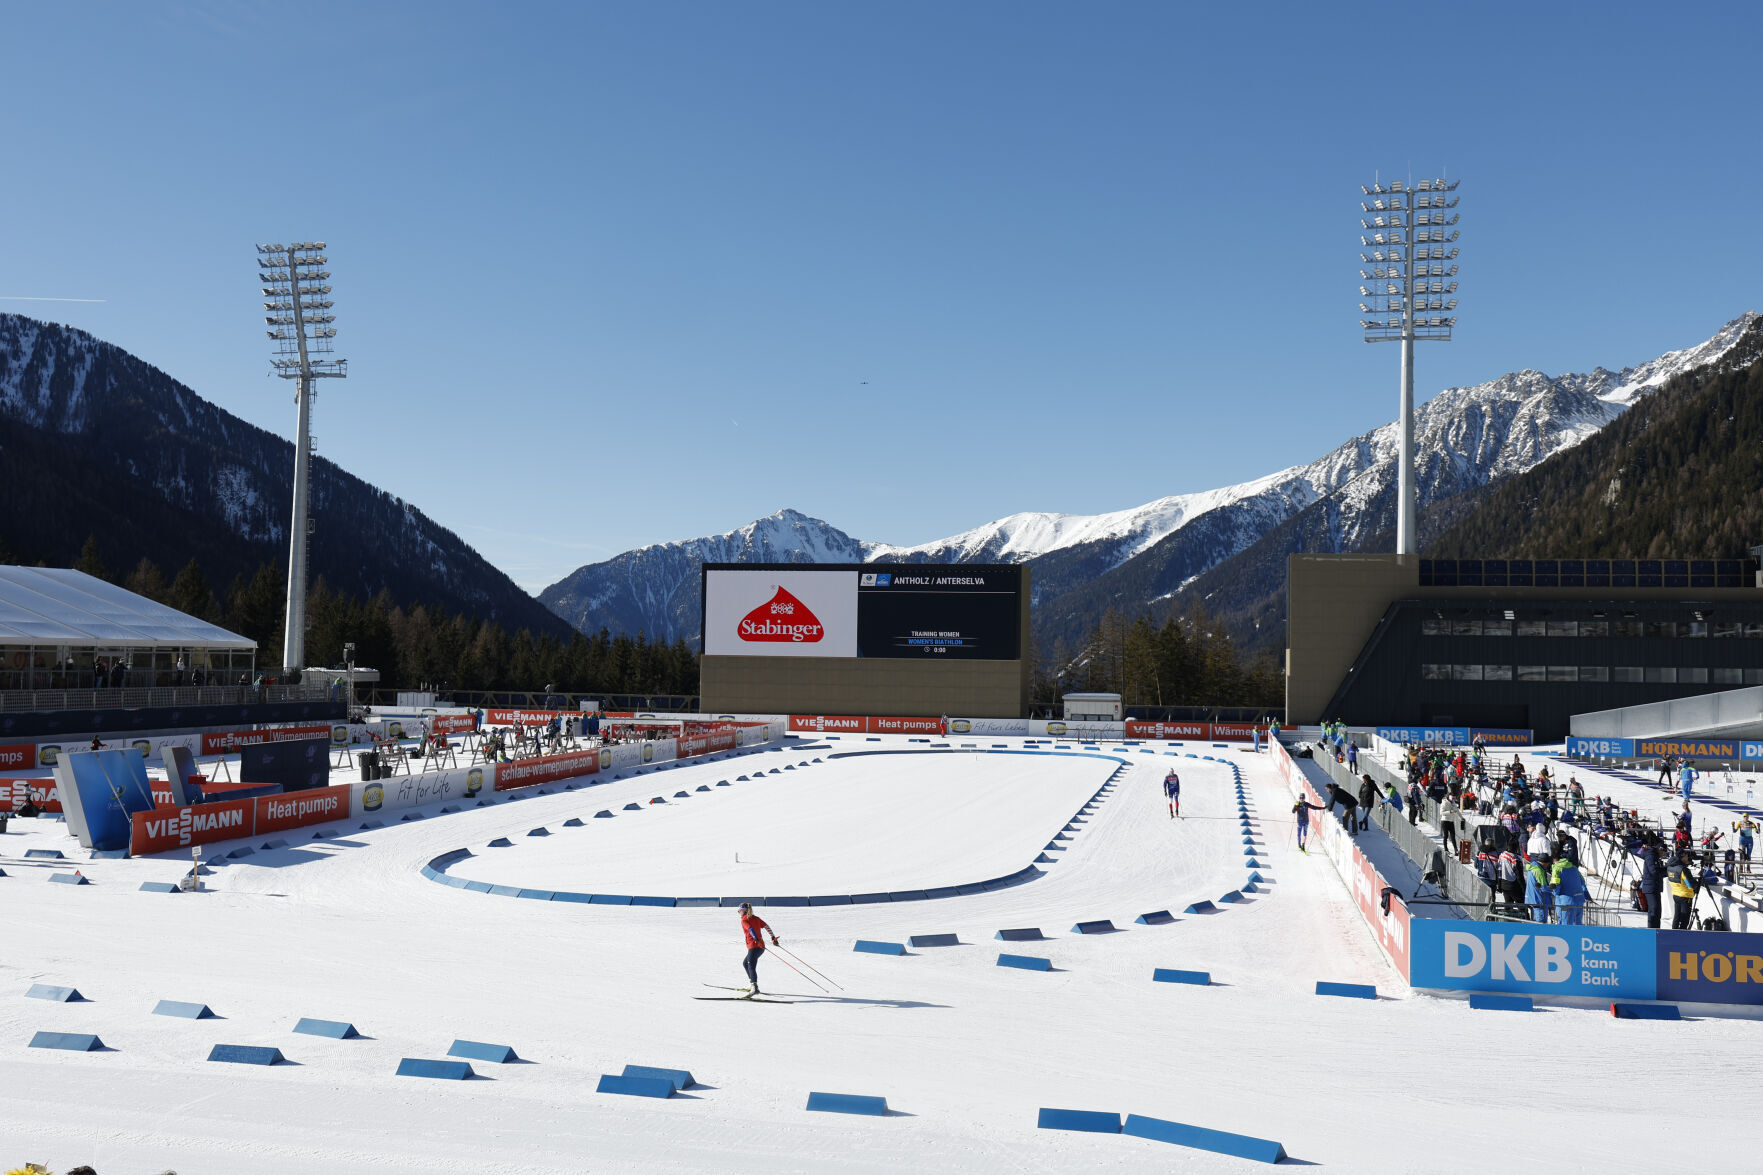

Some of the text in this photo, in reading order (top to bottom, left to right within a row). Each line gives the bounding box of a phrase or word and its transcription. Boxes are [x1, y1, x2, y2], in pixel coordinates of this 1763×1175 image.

[894, 577, 929, 585] ANTHOLZ
[936, 577, 985, 585] ANTERSELVA
[741, 619, 821, 641] Stabinger
[437, 716, 473, 732] VIESSMANN
[796, 716, 937, 731] VIESSMANN Heat pumps
[1133, 723, 1202, 738] VIESSMANN
[1380, 729, 1410, 740] DKB
[1425, 730, 1454, 741] DKB
[1577, 740, 1610, 753] DKB
[1641, 742, 1733, 756] HÖRMANN
[501, 756, 593, 781] schlaue-wärmepumpe.com
[398, 772, 451, 805] Fit for Life
[145, 795, 338, 845] VIESSMANN Heat pumps
[1581, 937, 1610, 952] Das
[1444, 931, 1572, 983] DKB
[1581, 954, 1618, 970] kann
[1669, 950, 1763, 983] HÖR
[1581, 971, 1620, 987] Bank
